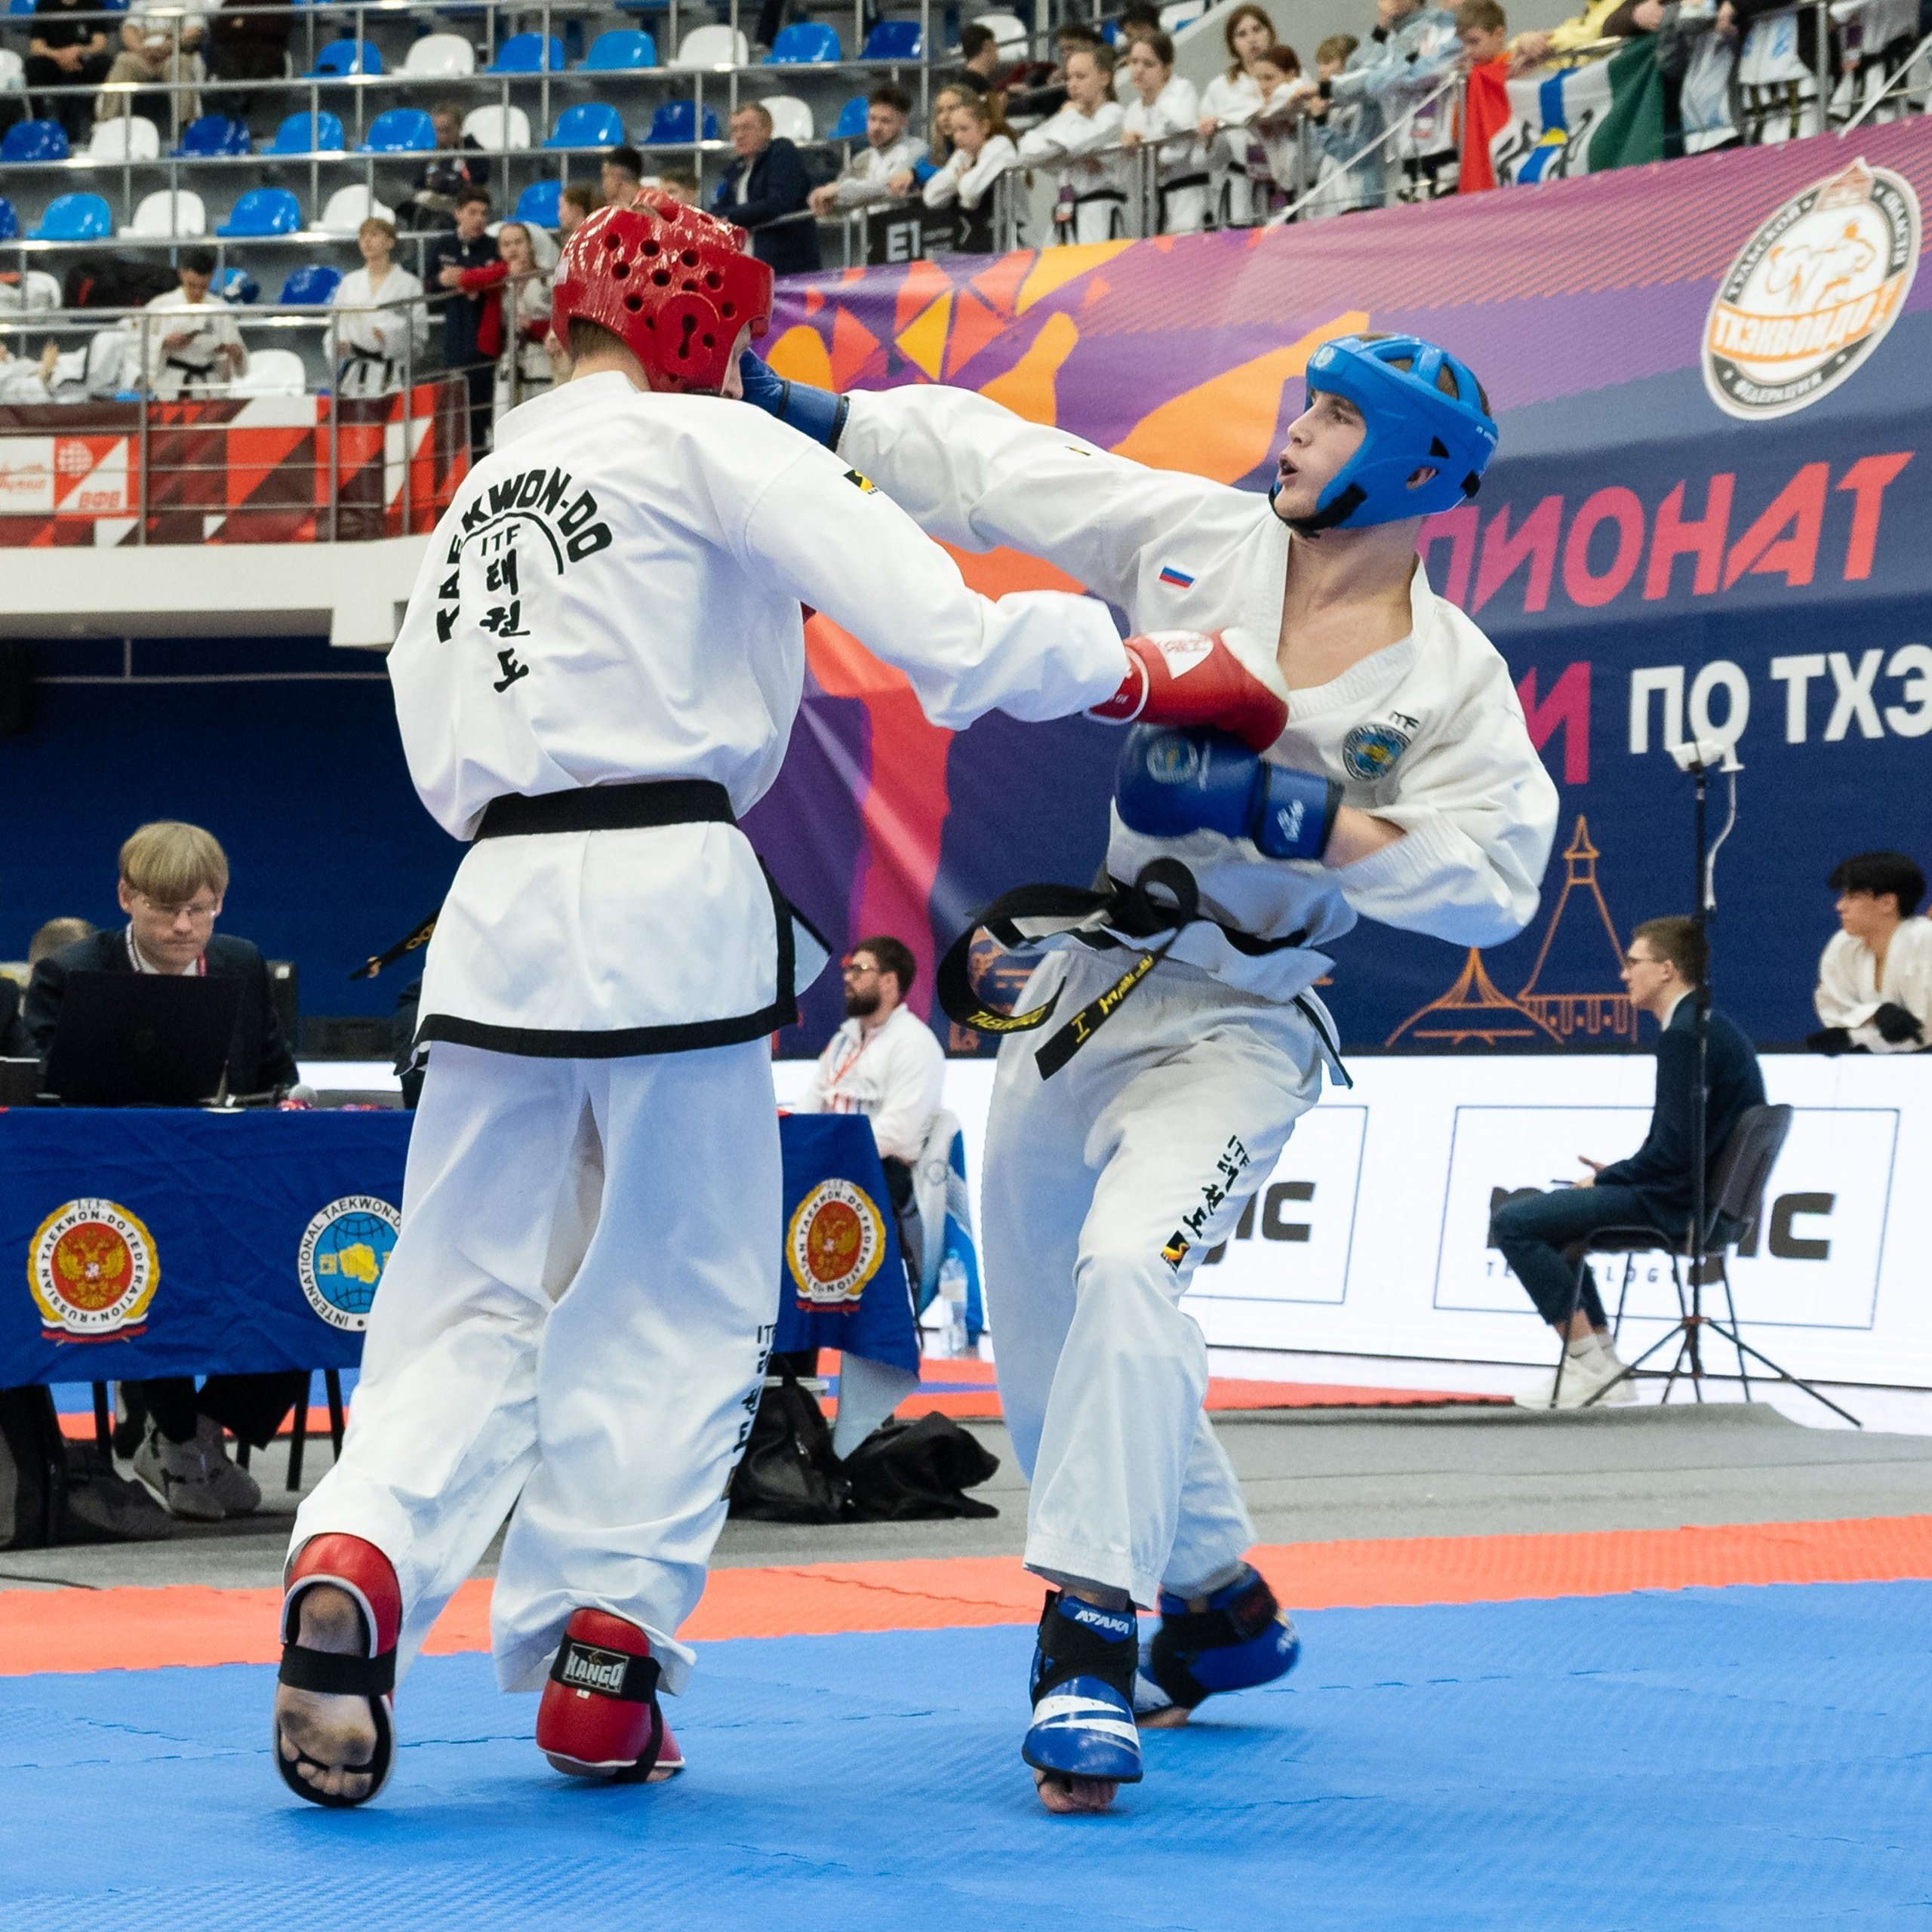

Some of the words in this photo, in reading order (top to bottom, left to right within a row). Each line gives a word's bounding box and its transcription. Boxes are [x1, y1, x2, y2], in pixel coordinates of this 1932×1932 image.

[481, 523, 521, 557] ITF
[1415, 451, 1916, 619] ПИОНАТ
[1629, 660, 1750, 755] ПО
[1770, 644, 1932, 744] ТХЭ
[1227, 1134, 1251, 1167] ITF
[42, 1211, 126, 1262] TAEKWON-DO
[321, 1198, 402, 1228] TAEKWON-D
[42, 1269, 88, 1322] RUSSIAN
[100, 1232, 145, 1322] FEDERATION
[300, 1221, 349, 1327] INTERNATIONAL
[757, 1324, 777, 1346] IT
[565, 1650, 626, 1687] KANGO
